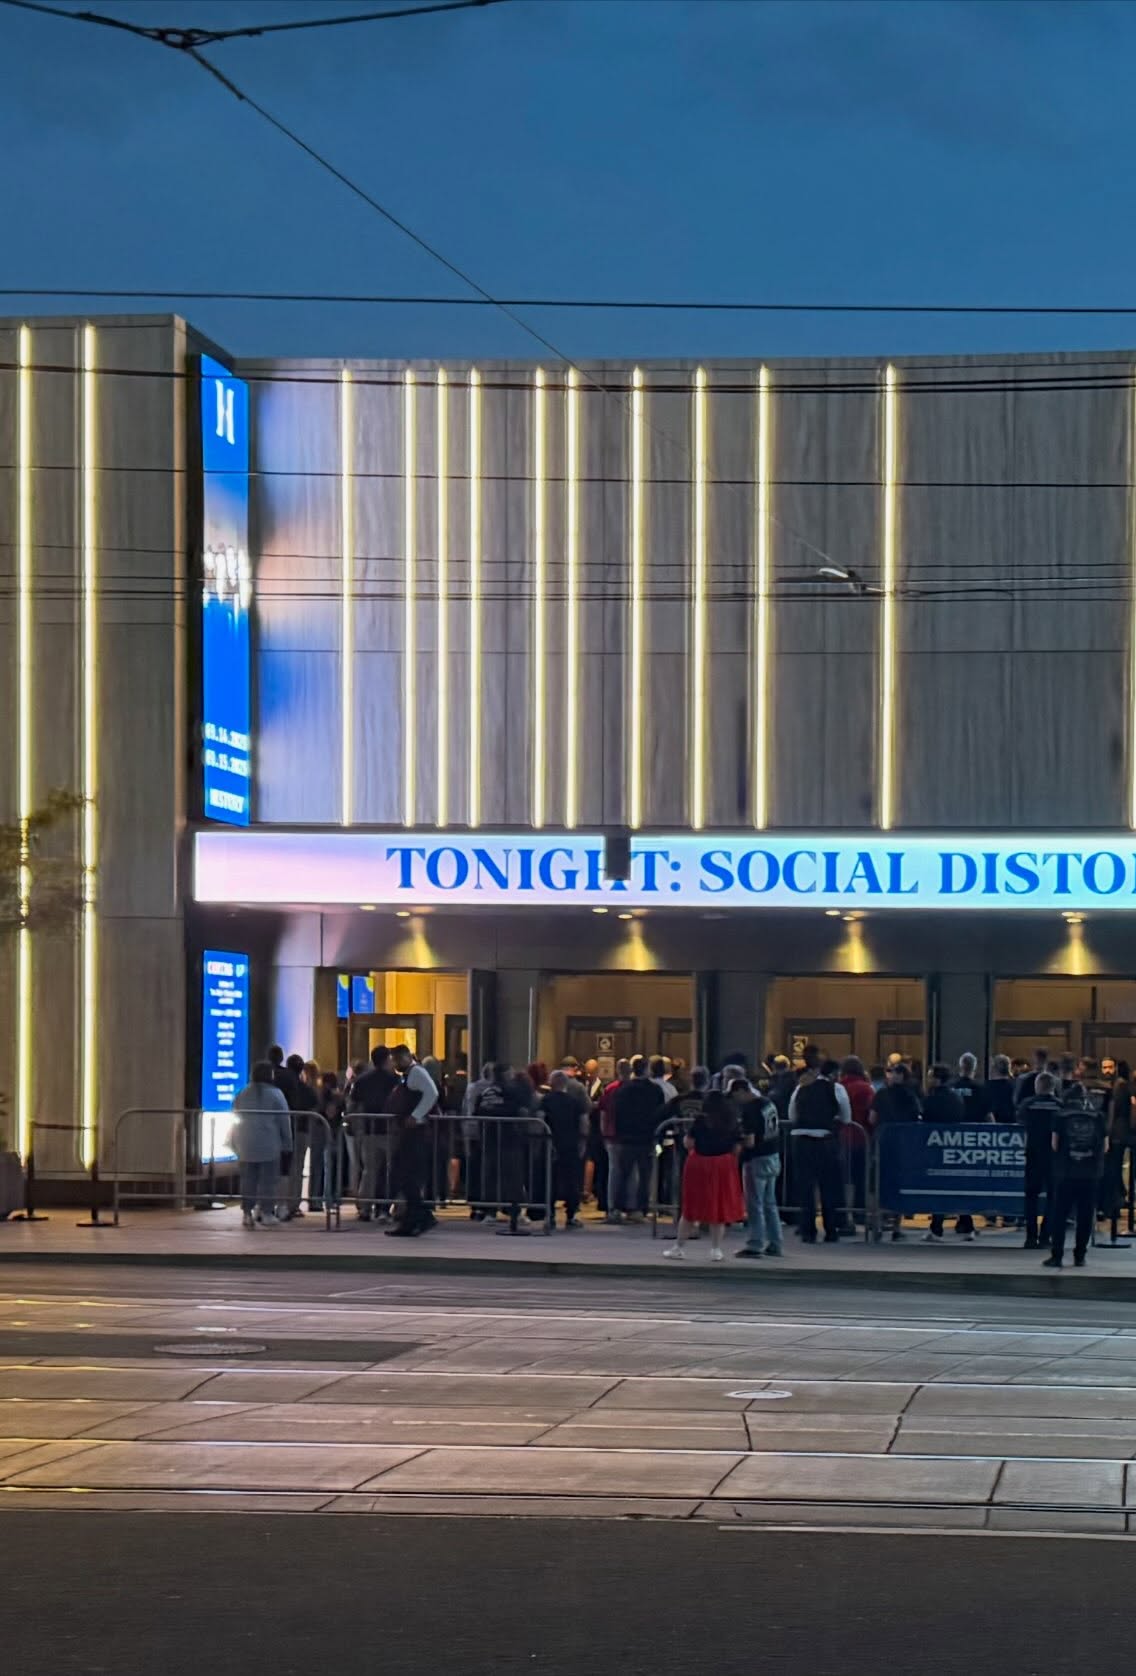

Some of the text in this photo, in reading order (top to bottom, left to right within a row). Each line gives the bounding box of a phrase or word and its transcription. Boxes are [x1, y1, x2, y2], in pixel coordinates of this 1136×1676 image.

[699, 849, 920, 895] SOCIAL
[927, 1130, 1027, 1148] AMERICA
[942, 1149, 1027, 1166] EXPRES
